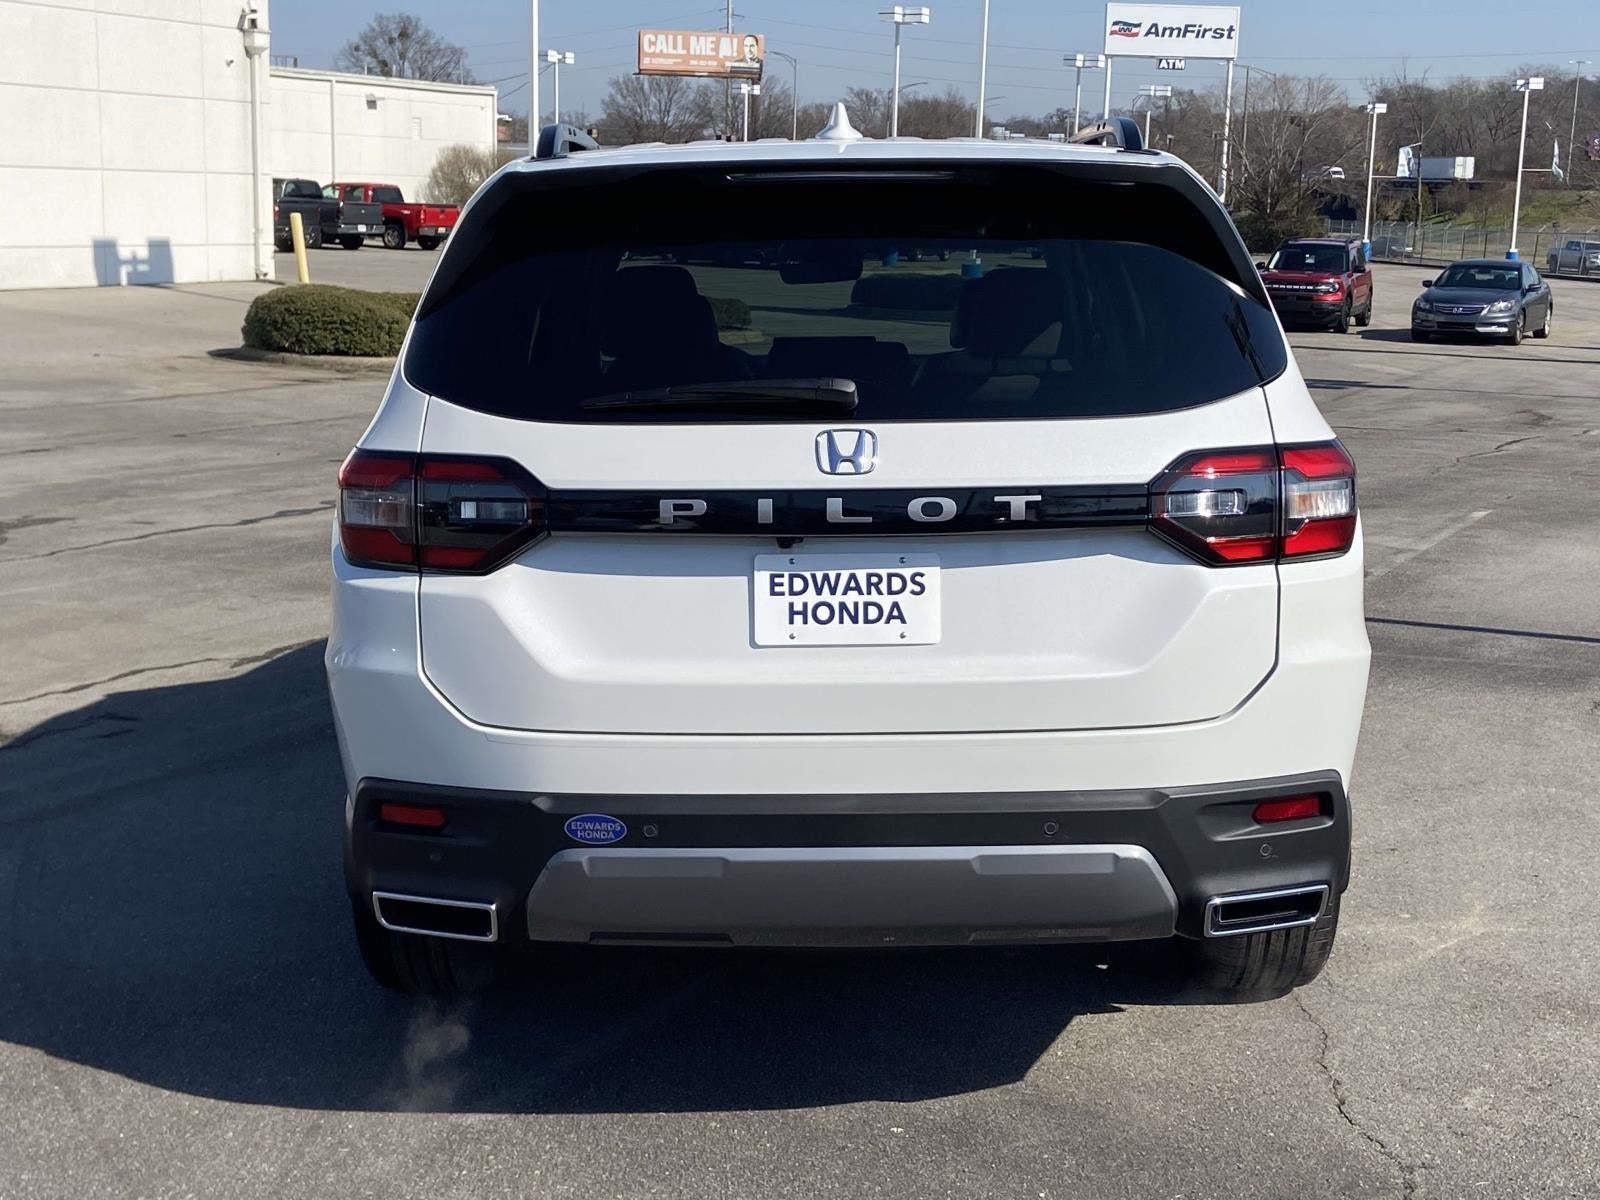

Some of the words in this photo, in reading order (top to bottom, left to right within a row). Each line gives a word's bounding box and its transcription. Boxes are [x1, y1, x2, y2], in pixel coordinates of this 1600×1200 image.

[1143, 23, 1236, 40] AmFirst
[643, 33, 687, 55] CALL
[689, 35, 717, 56] ME
[1159, 59, 1185, 70] ATM
[659, 495, 1042, 525] PILOT
[769, 571, 926, 597] EDWARDS
[788, 601, 908, 625] HONDA
[571, 821, 621, 832] EDWARDS
[577, 830, 616, 839] HONDA
